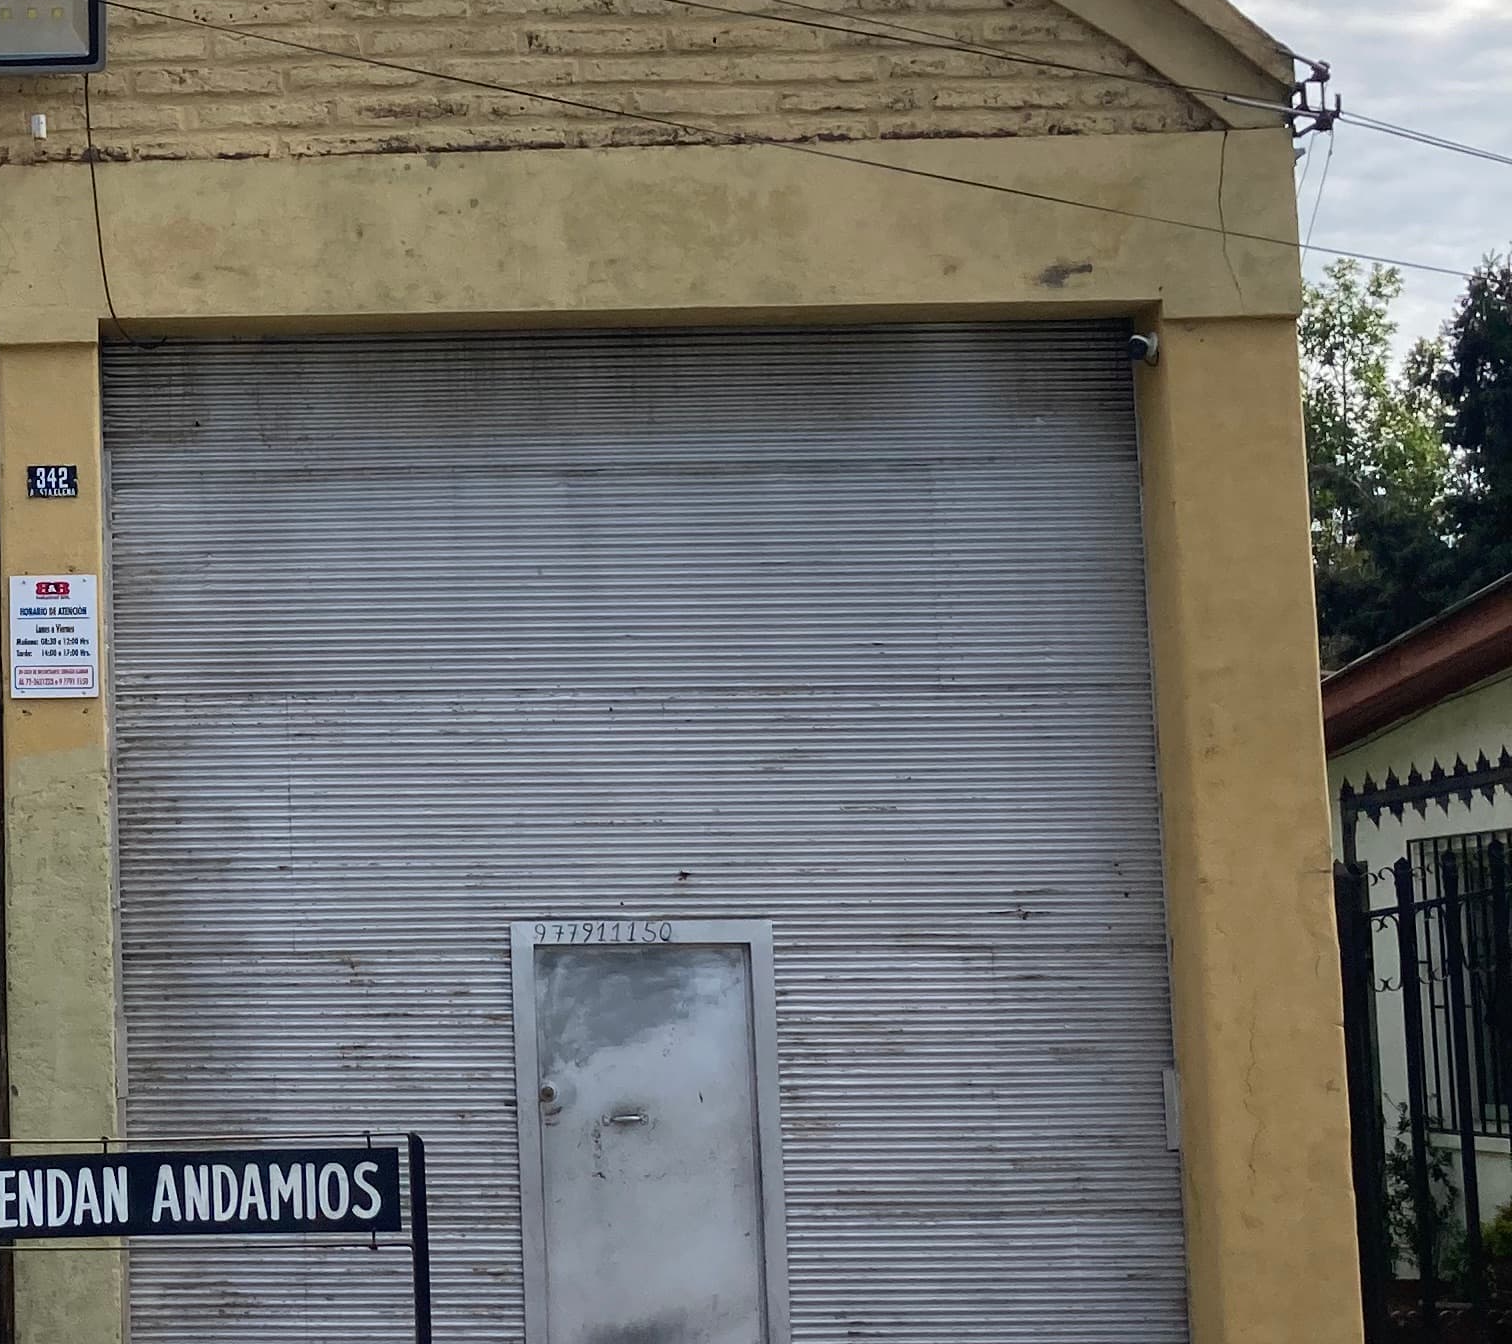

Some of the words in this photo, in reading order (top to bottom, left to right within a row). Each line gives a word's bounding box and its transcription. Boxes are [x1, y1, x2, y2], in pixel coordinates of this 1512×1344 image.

[36, 467, 68, 488] 342
[19, 607, 48, 616] HORARIO
[48, 607, 56, 616] DE
[35, 624, 50, 633] Lunes
[55, 623, 75, 633] Viernes
[534, 921, 673, 943] 977911150
[151, 1161, 382, 1224] ANDAMIOS
